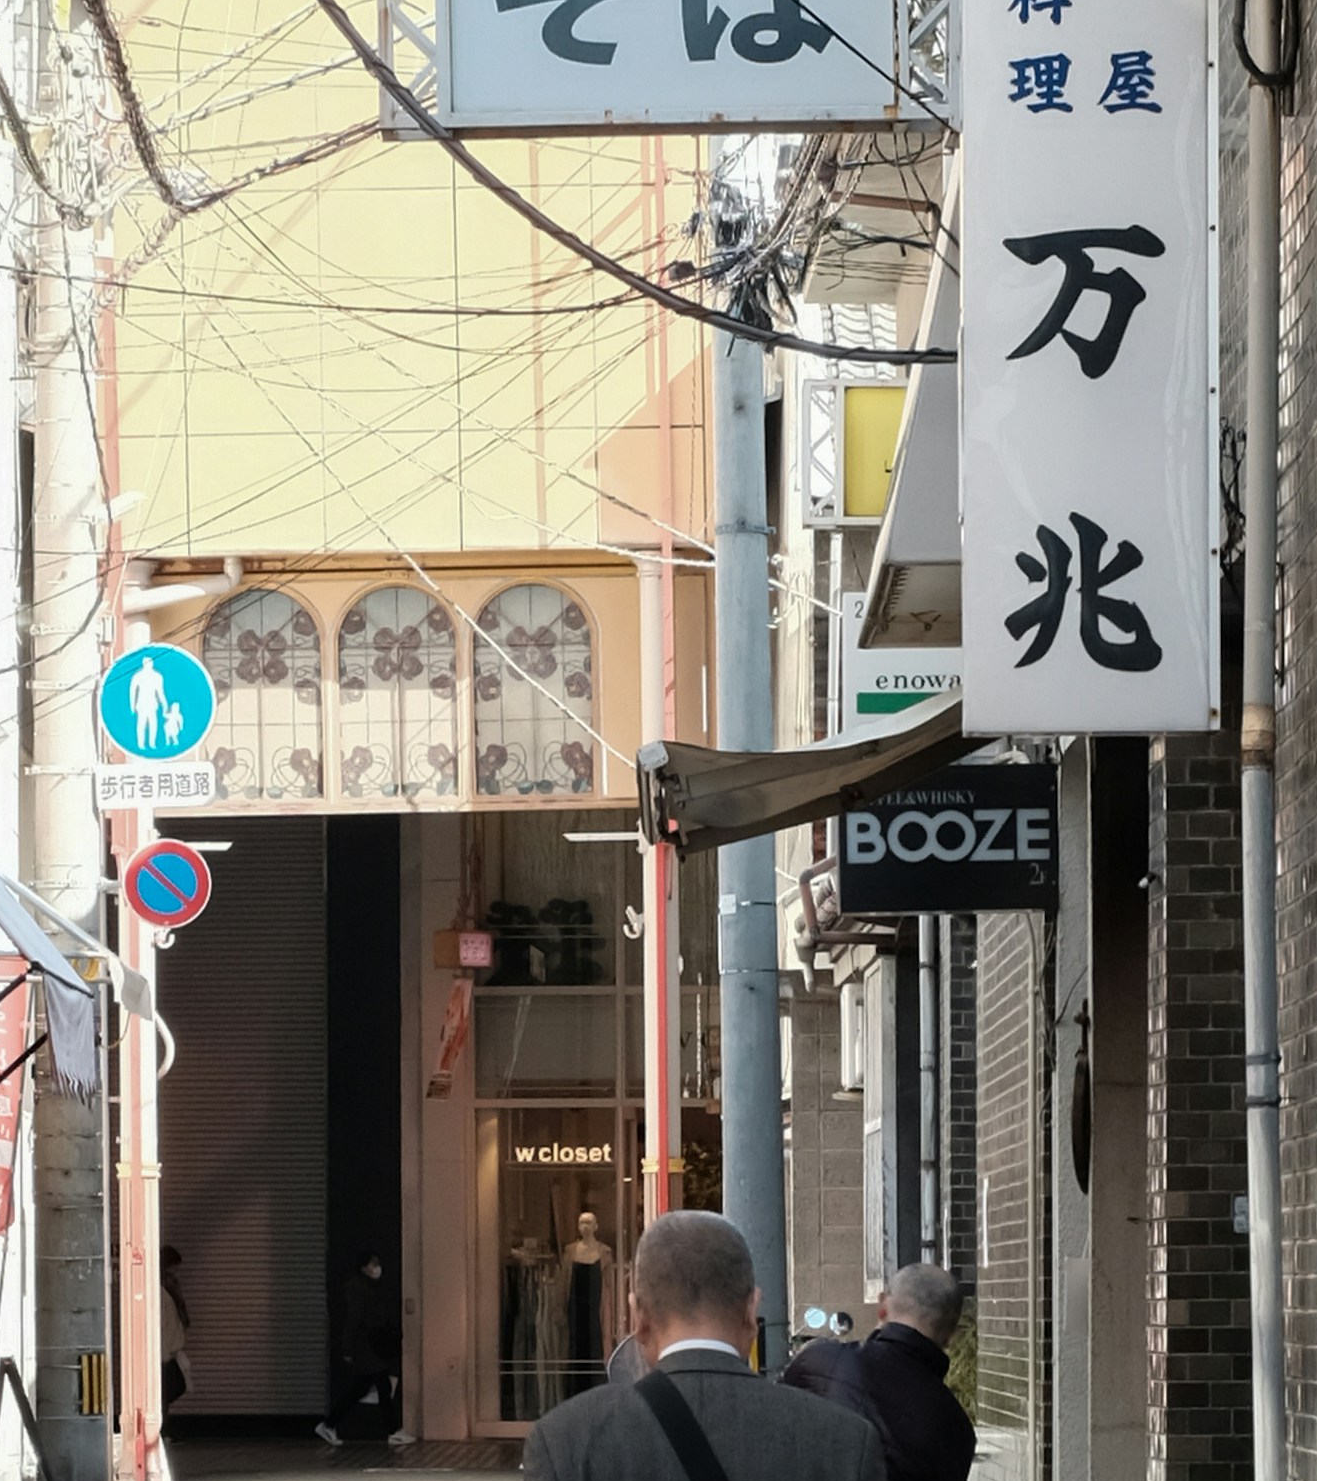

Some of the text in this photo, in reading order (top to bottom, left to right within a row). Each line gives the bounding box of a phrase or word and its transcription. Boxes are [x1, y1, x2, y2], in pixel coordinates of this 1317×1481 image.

[1002, 223, 1168, 673] 万兆
[100, 771, 211, 801] 歩行者用道路
[870, 789, 977, 806] FEE&WHISKY
[845, 807, 1051, 865] BOOZE
[515, 1142, 612, 1163] w closet
